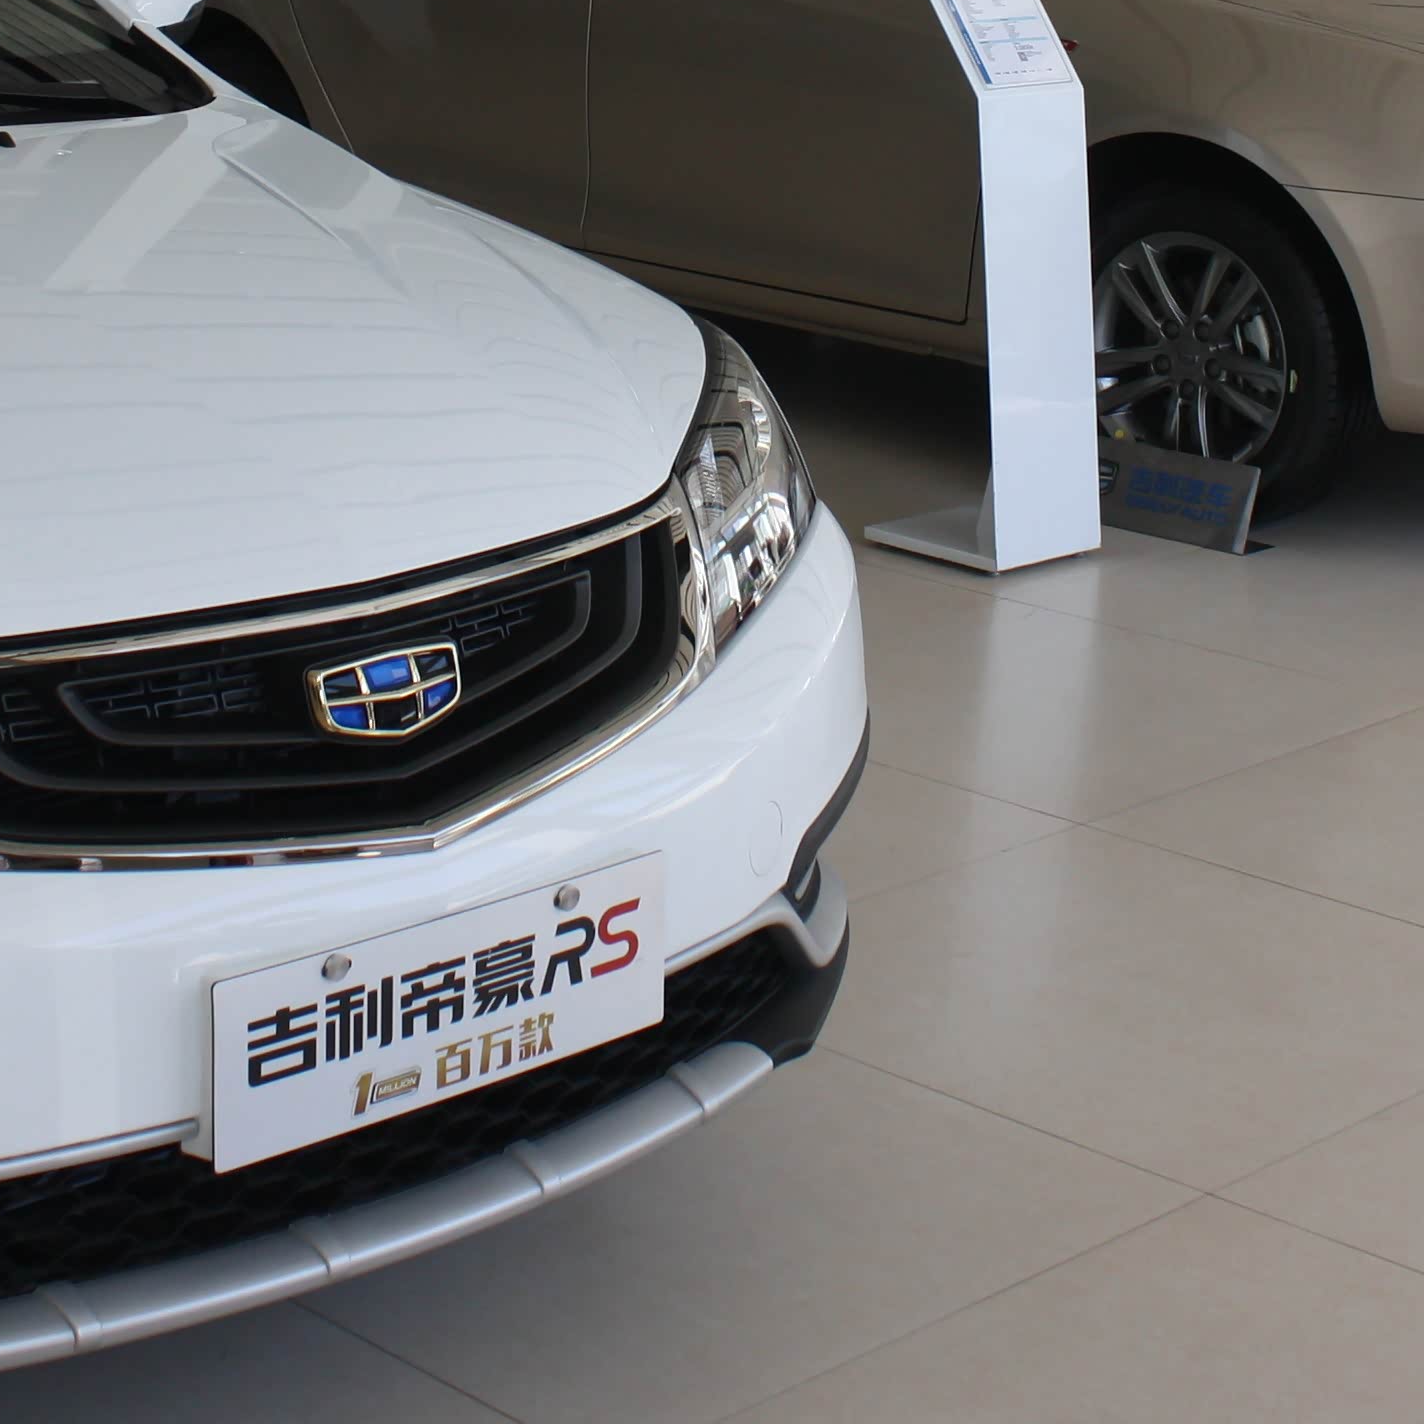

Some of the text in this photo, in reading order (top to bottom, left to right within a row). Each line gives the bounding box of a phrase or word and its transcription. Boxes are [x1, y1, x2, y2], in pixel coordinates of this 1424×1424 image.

[377, 1074, 419, 1097] MILLION
[434, 1010, 555, 1090] 百万款
